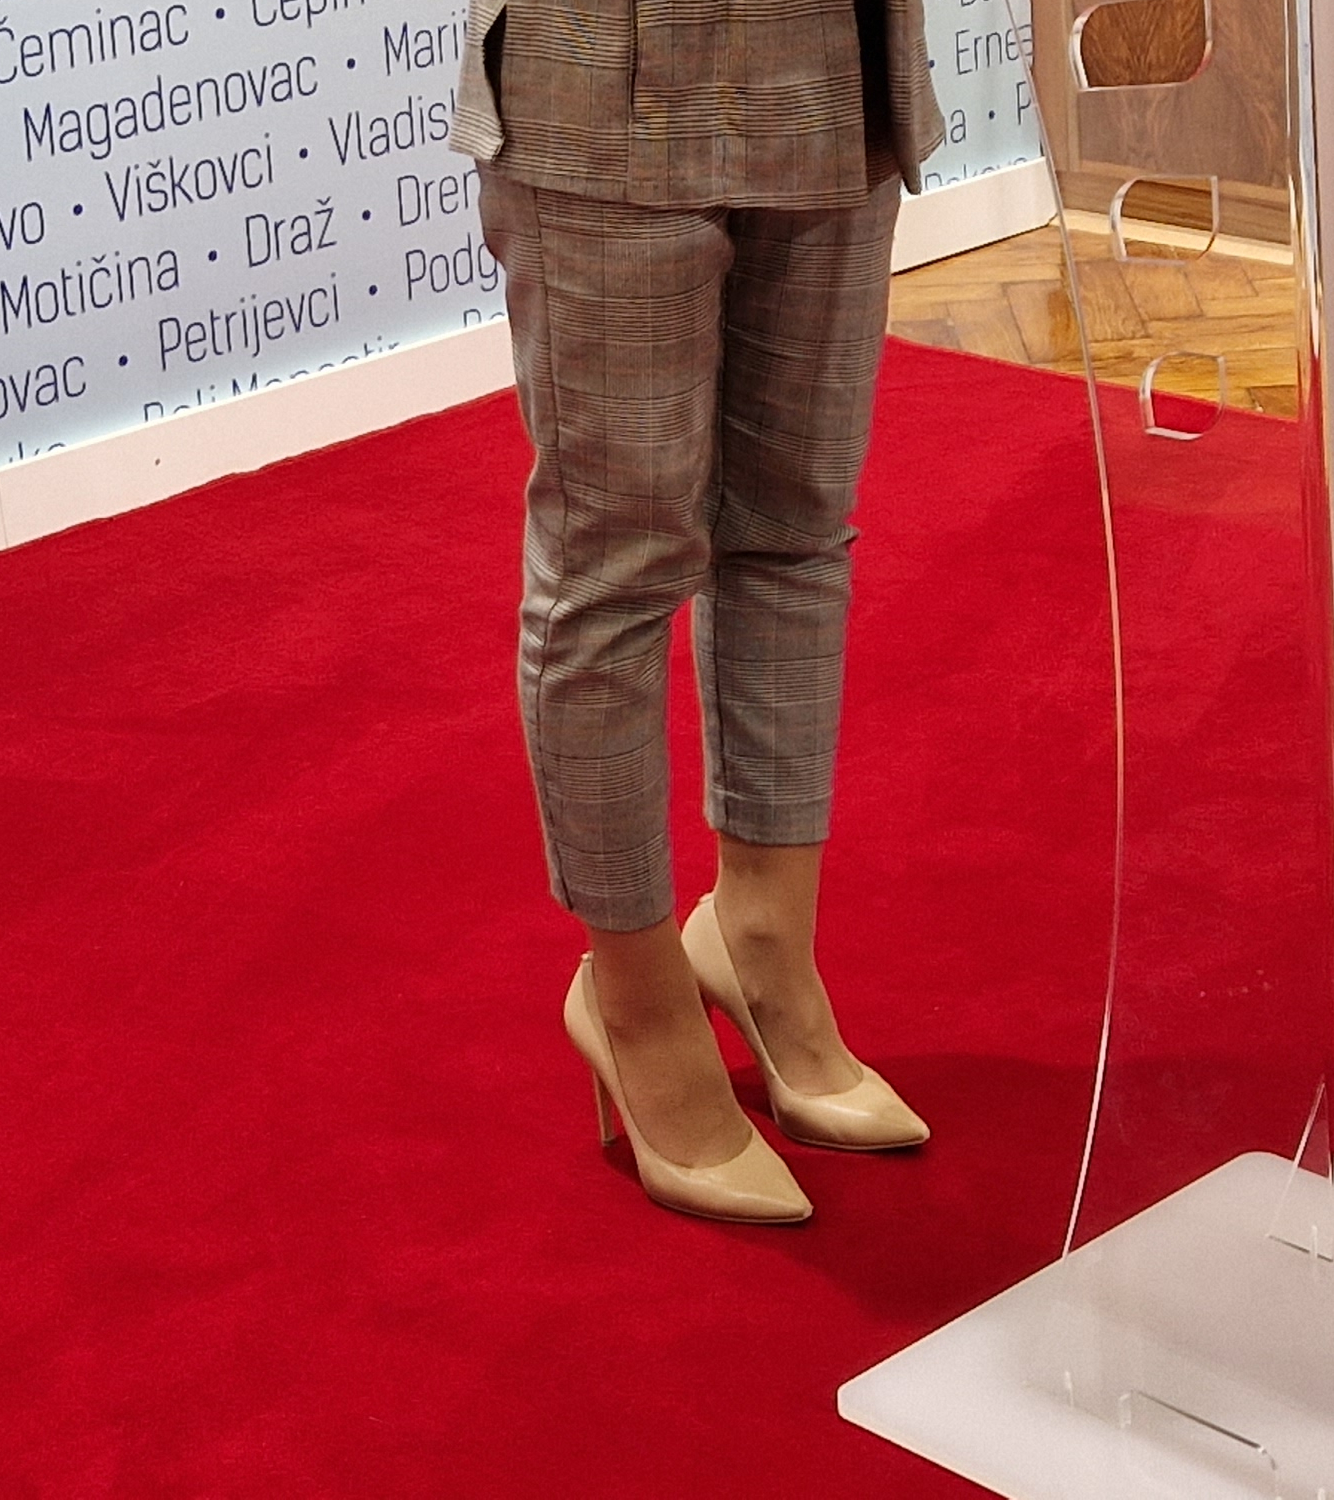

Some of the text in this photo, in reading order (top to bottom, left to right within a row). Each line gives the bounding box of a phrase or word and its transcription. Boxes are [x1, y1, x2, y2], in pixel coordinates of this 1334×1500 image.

[23, 56, 318, 162] Magadenovac
[104, 132, 273, 222] Viškovci
[0, 250, 179, 335] Motičina
[245, 196, 337, 268] Draž
[397, 170, 480, 228] Dren
[158, 272, 339, 372] Petrijevci
[405, 232, 499, 301] Podg
